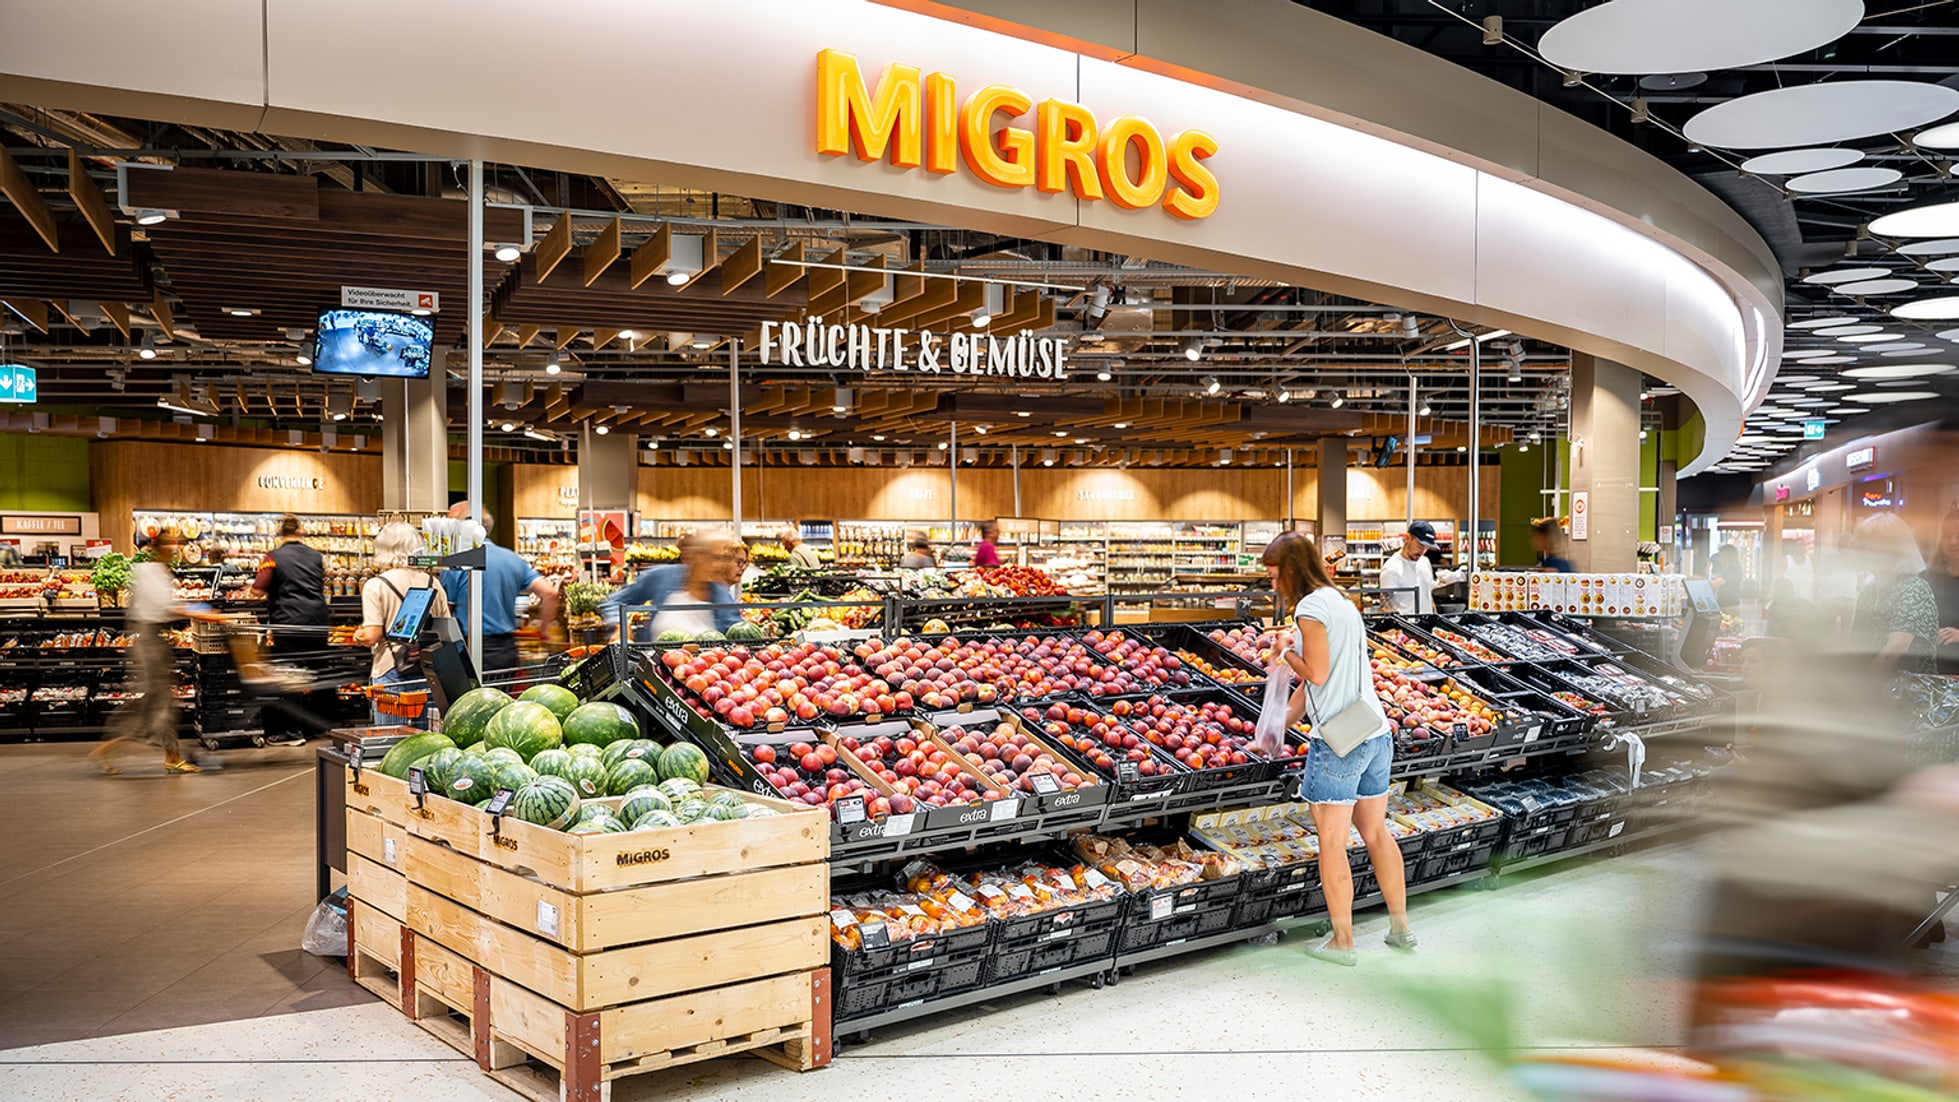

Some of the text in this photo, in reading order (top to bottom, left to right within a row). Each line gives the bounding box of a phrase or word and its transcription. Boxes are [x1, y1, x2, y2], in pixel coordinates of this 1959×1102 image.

[817, 48, 1220, 220] MIGROS
[347, 289, 405, 299] Videoüberwacht
[760, 315, 1069, 379] FRÜCHTE & GEMÜSE
[16, 519, 44, 530] KAFFEE
[53, 520, 65, 530] TEE
[665, 696, 689, 724] extra
[1054, 793, 1080, 807] extra
[960, 808, 987, 823] extra
[616, 848, 670, 866] MIGROS
